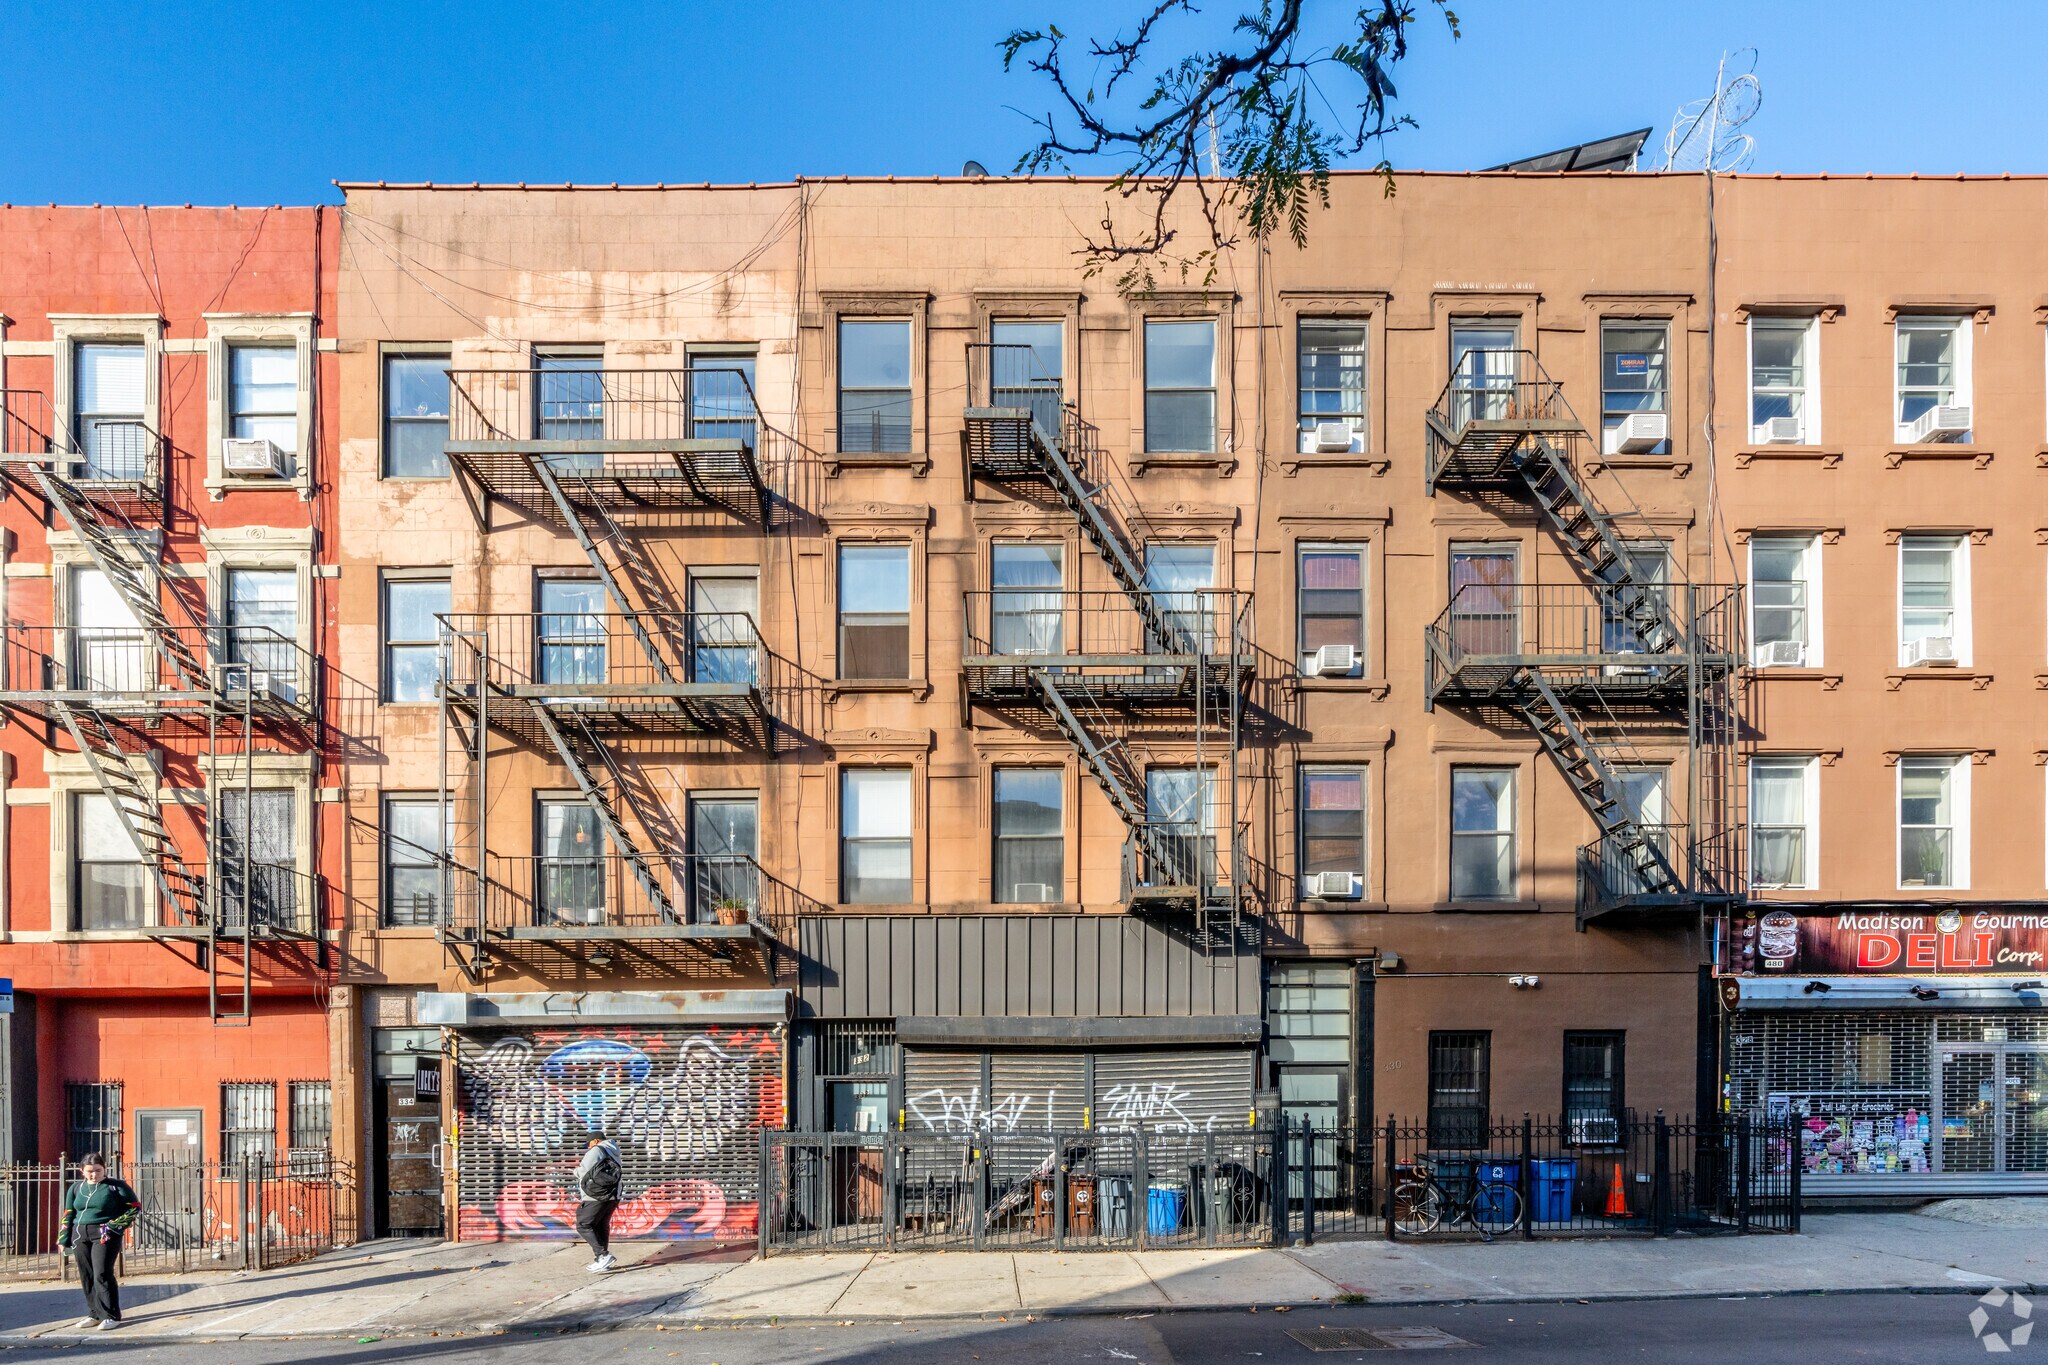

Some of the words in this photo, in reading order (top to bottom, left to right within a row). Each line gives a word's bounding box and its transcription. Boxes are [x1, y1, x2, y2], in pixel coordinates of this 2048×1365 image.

[1837, 912, 1923, 930] Madison
[1857, 933, 1994, 968] DELI
[1997, 948, 2044, 966] Corp.
[1384, 1060, 1402, 1072] 330
